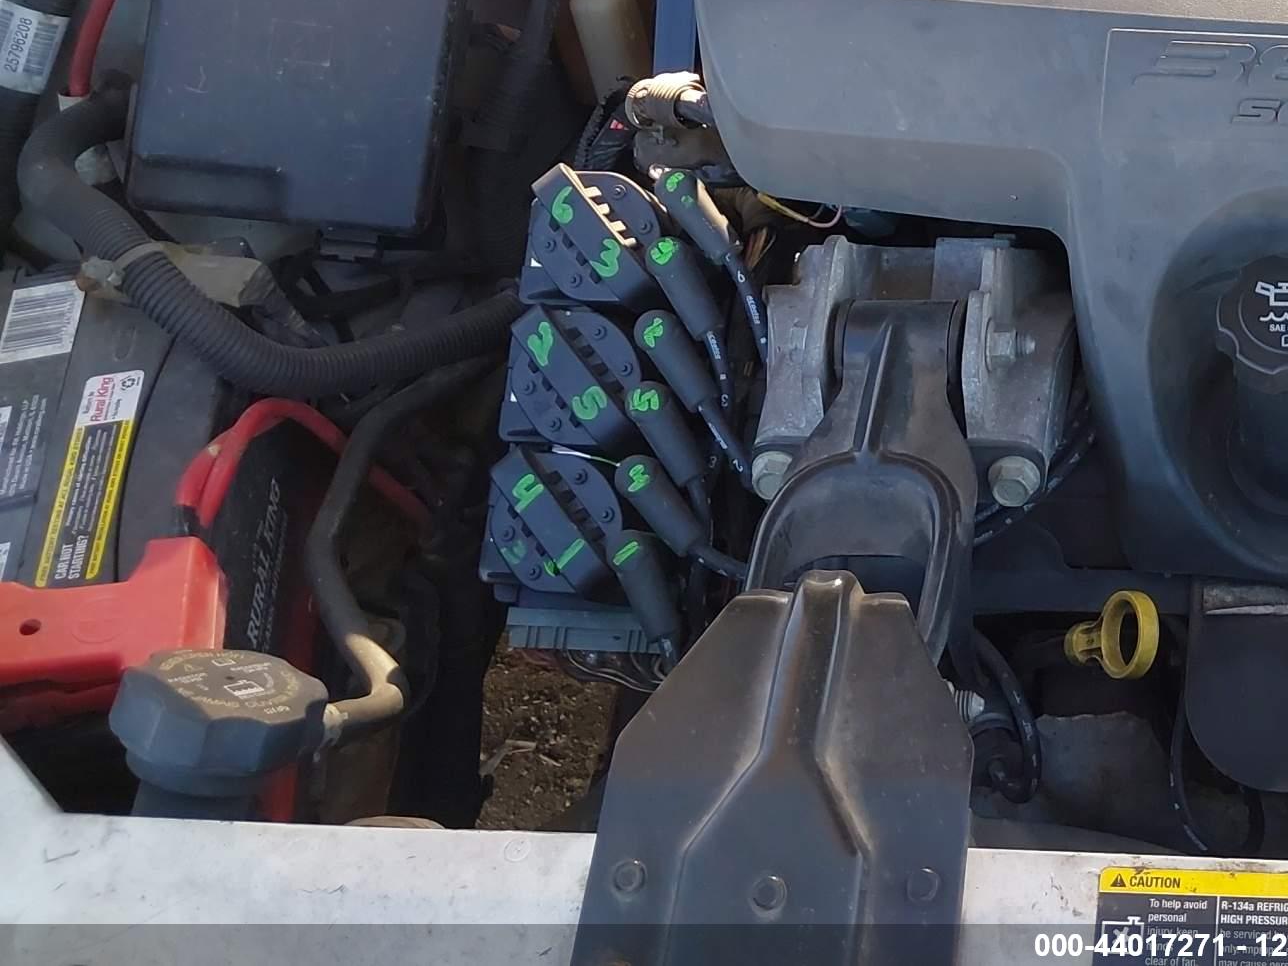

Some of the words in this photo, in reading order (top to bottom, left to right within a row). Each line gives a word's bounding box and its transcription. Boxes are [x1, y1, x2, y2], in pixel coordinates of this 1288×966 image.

[4, 17, 32, 73] 25796208
[552, 186, 574, 224] 6
[591, 238, 621, 277] 3
[1269, 324, 1285, 332] SAE
[97, 377, 114, 397] King
[90, 398, 106, 422] Rural
[61, 543, 73, 561] NOT
[68, 534, 89, 580] STARTING?
[55, 561, 69, 580] CAR
[246, 550, 271, 650] RURAL
[264, 475, 281, 548] KING
[1129, 876, 1180, 888] CAUTION
[1149, 898, 1159, 908] To
[1162, 899, 1181, 910] help
[1183, 900, 1207, 909] avoid
[1221, 900, 1254, 911] R-134a
[1148, 914, 1187, 925] personal
[1220, 914, 1243, 924] HIGH
